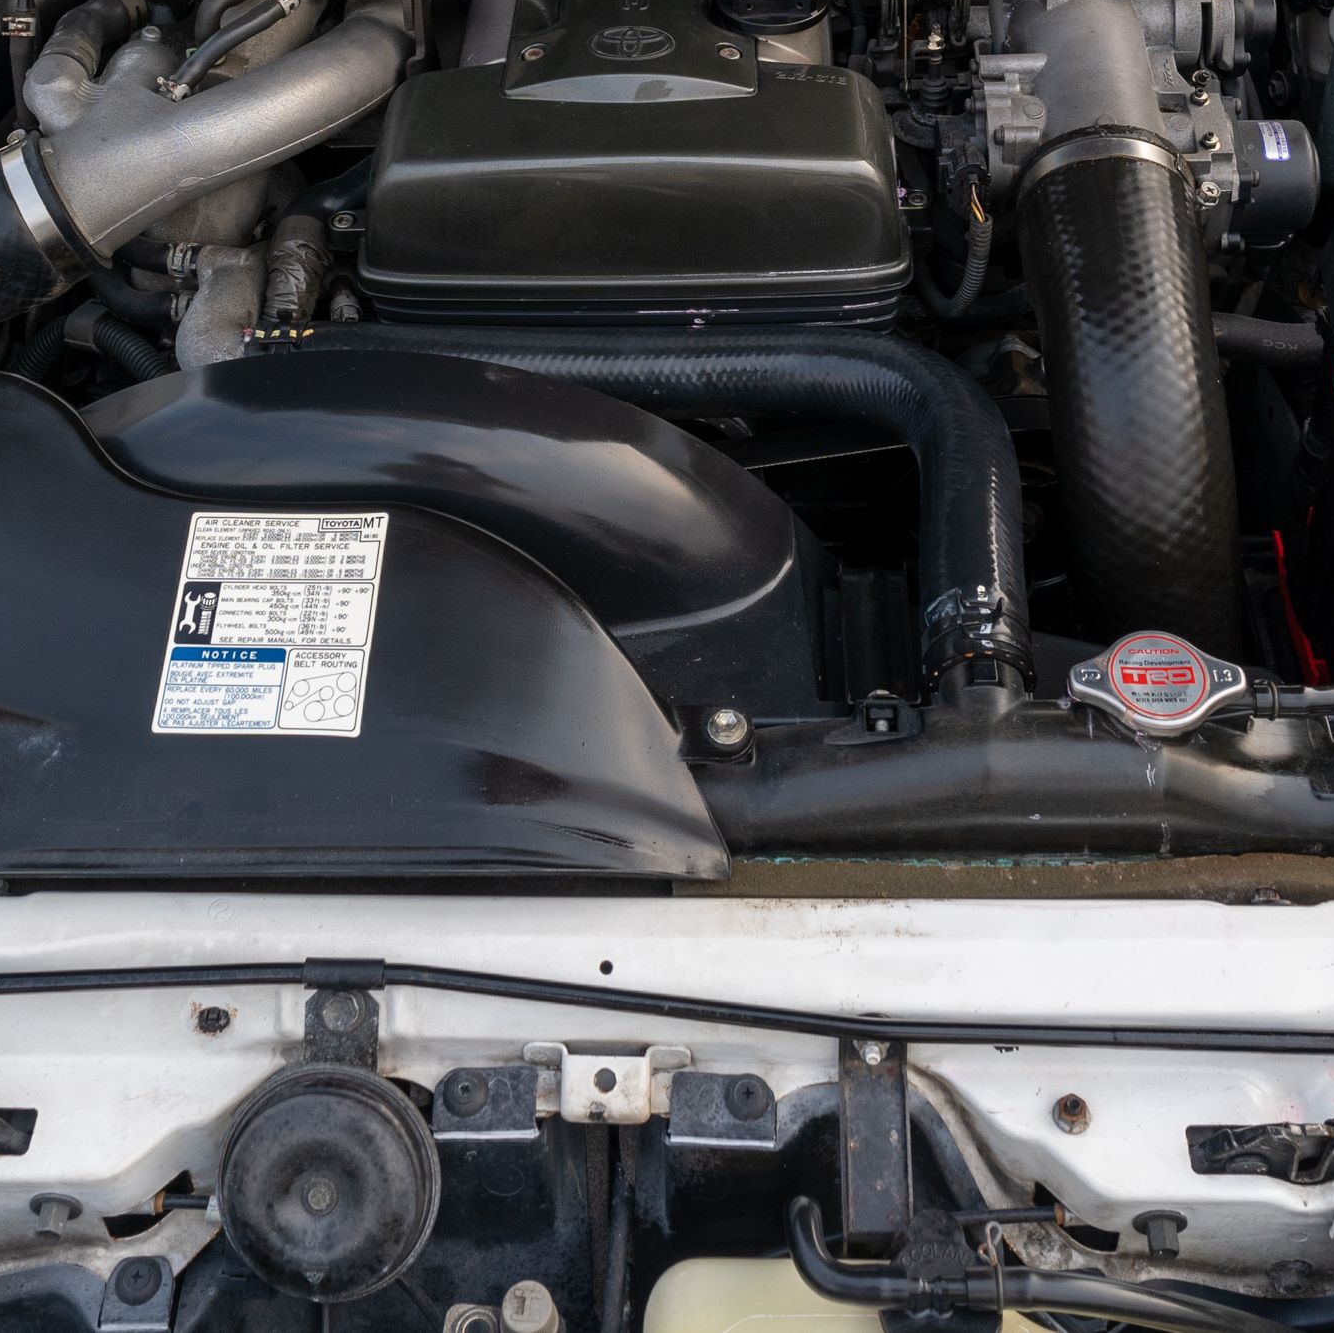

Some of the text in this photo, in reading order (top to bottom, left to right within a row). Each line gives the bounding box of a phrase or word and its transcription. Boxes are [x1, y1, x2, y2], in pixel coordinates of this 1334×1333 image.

[363, 516, 385, 528] MT
[201, 650, 258, 660] NOTICE
[294, 660, 316, 668] BELT
[1118, 659, 1192, 667] Racing Development
[1123, 669, 1192, 685] TRD
[1212, 669, 1233, 683] 1.3
